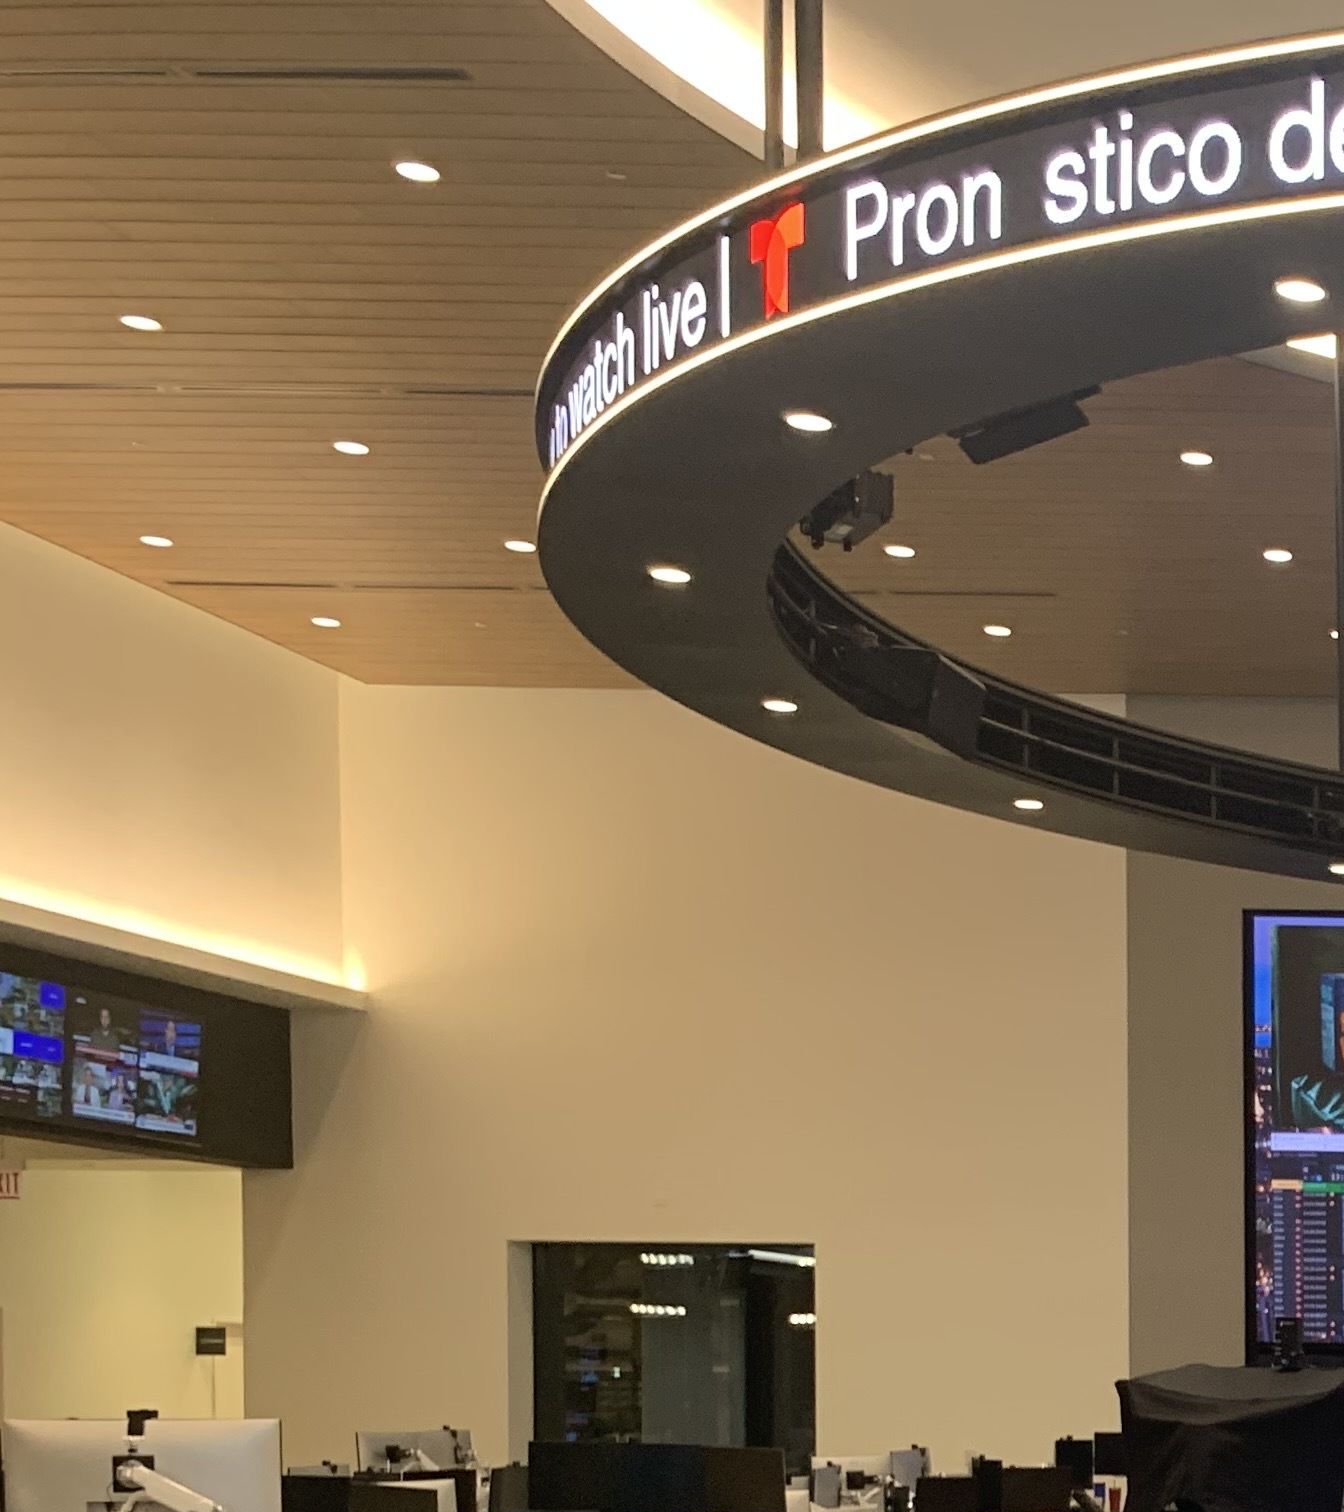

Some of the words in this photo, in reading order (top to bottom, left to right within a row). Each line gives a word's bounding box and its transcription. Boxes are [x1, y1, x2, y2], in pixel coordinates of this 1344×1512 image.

[567, 312, 635, 439] watch
[643, 284, 708, 376] live
[844, 172, 1003, 281] Pron
[1044, 108, 1244, 227] stico
